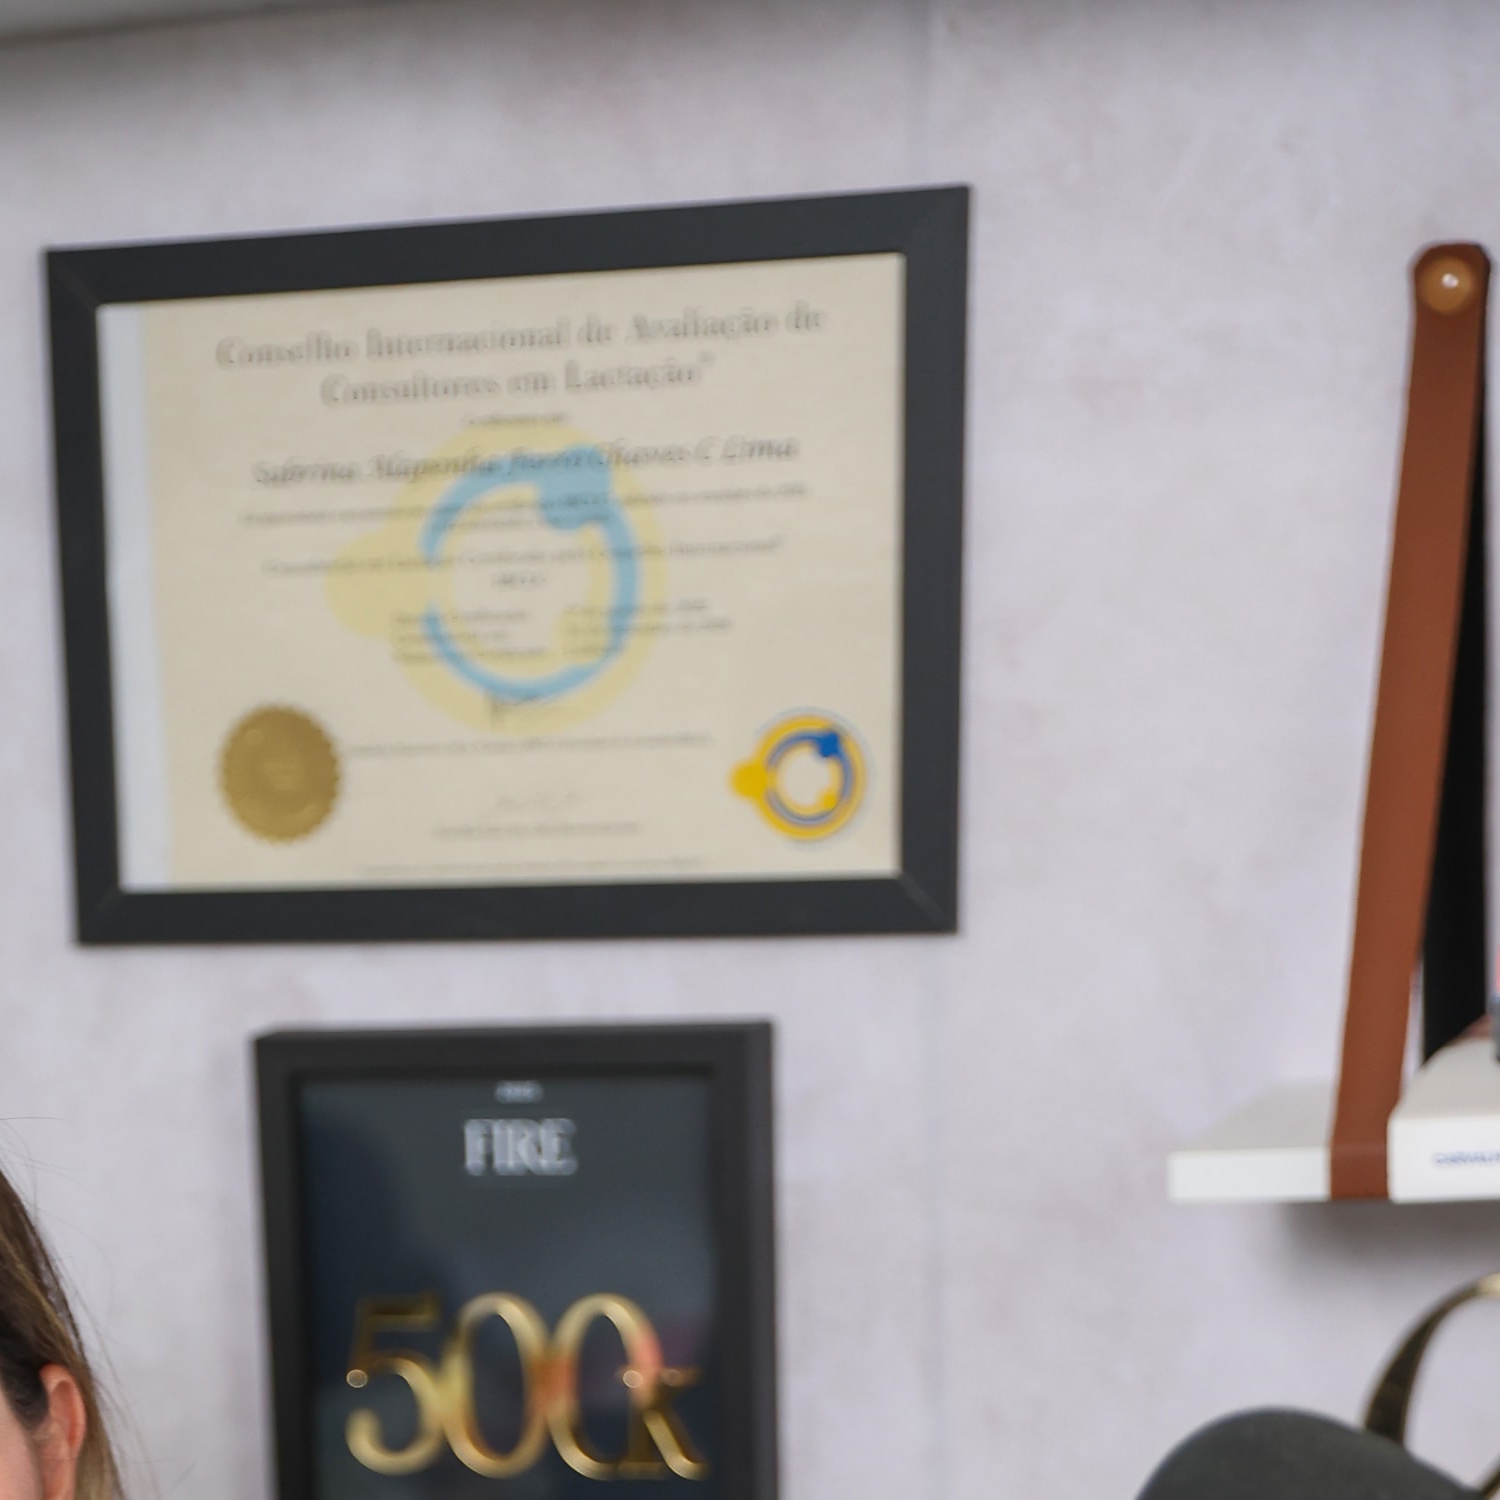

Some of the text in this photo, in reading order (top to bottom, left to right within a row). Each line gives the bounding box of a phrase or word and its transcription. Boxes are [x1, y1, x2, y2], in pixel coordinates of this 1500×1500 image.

[215, 330, 357, 371] Conselho
[365, 315, 570, 360] Internacional
[464, 1118, 578, 1177] FIRE
